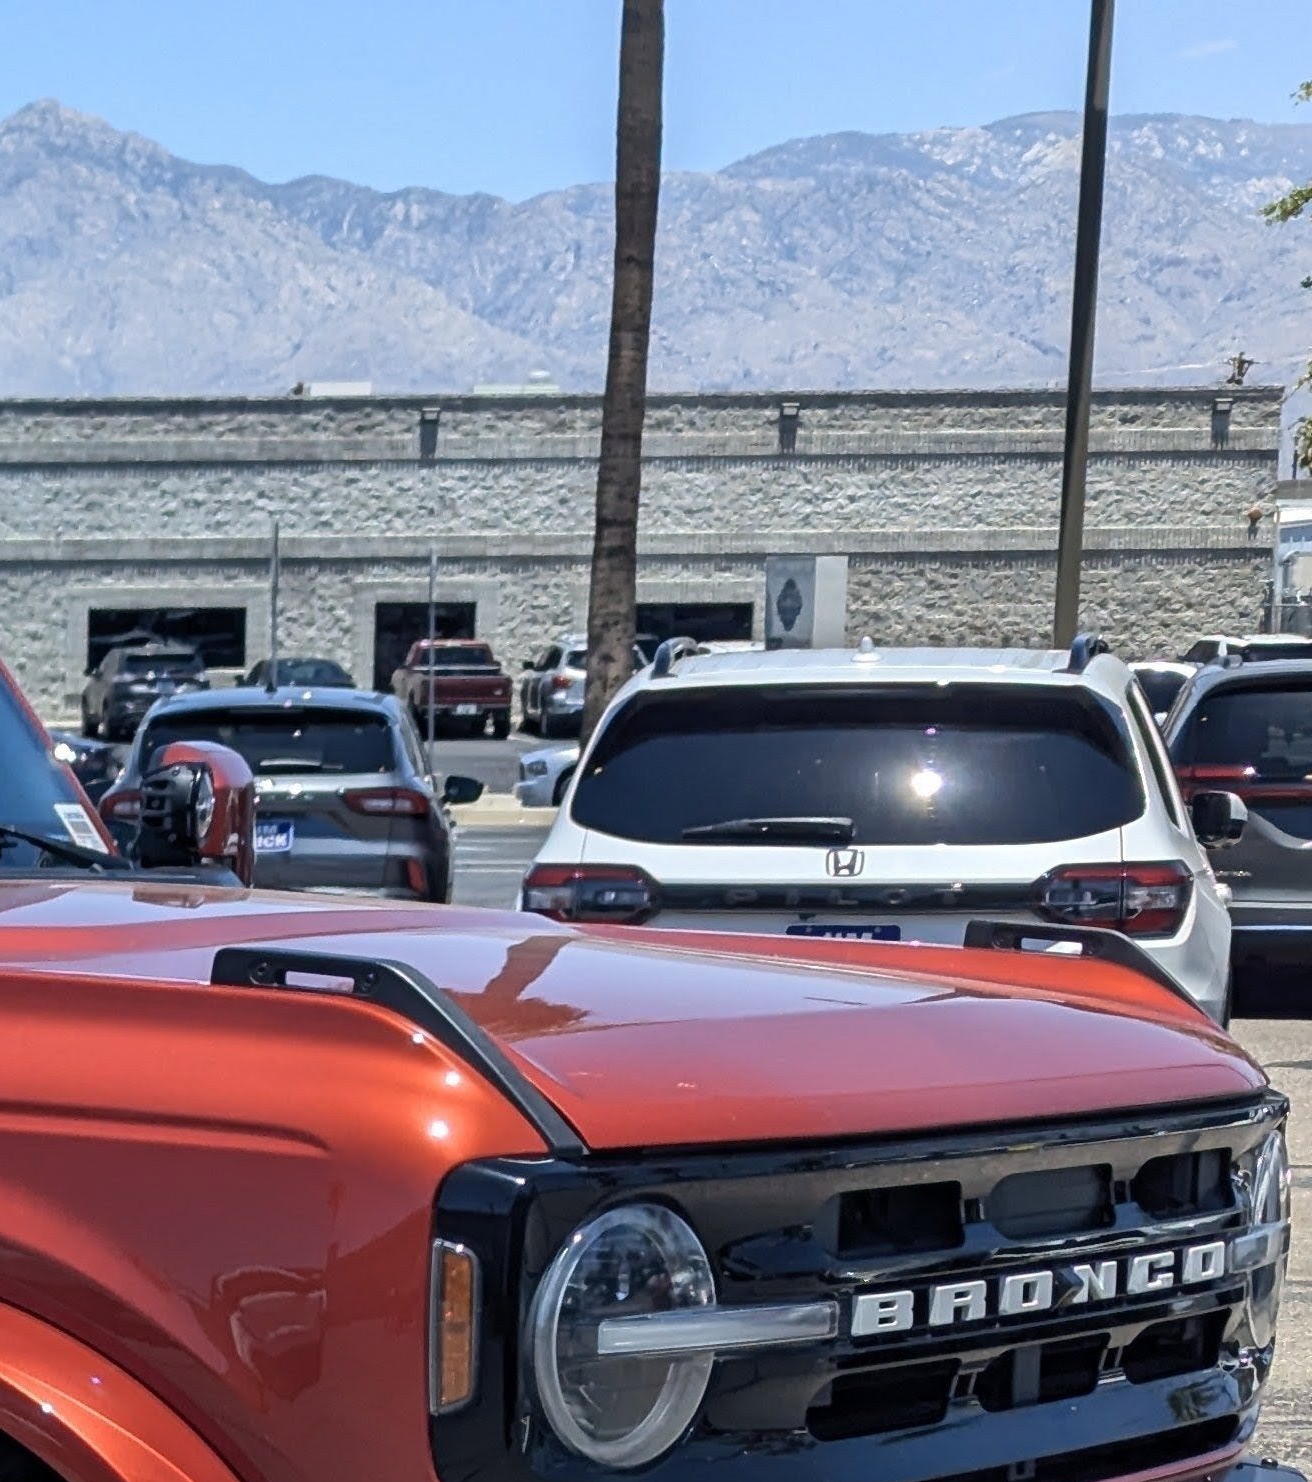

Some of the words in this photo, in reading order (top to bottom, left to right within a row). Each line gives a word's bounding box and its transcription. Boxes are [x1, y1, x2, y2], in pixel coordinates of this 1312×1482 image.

[257, 834, 287, 848] ICK
[724, 887, 964, 905] PILOT
[850, 1240, 1226, 1338] BRONCO
